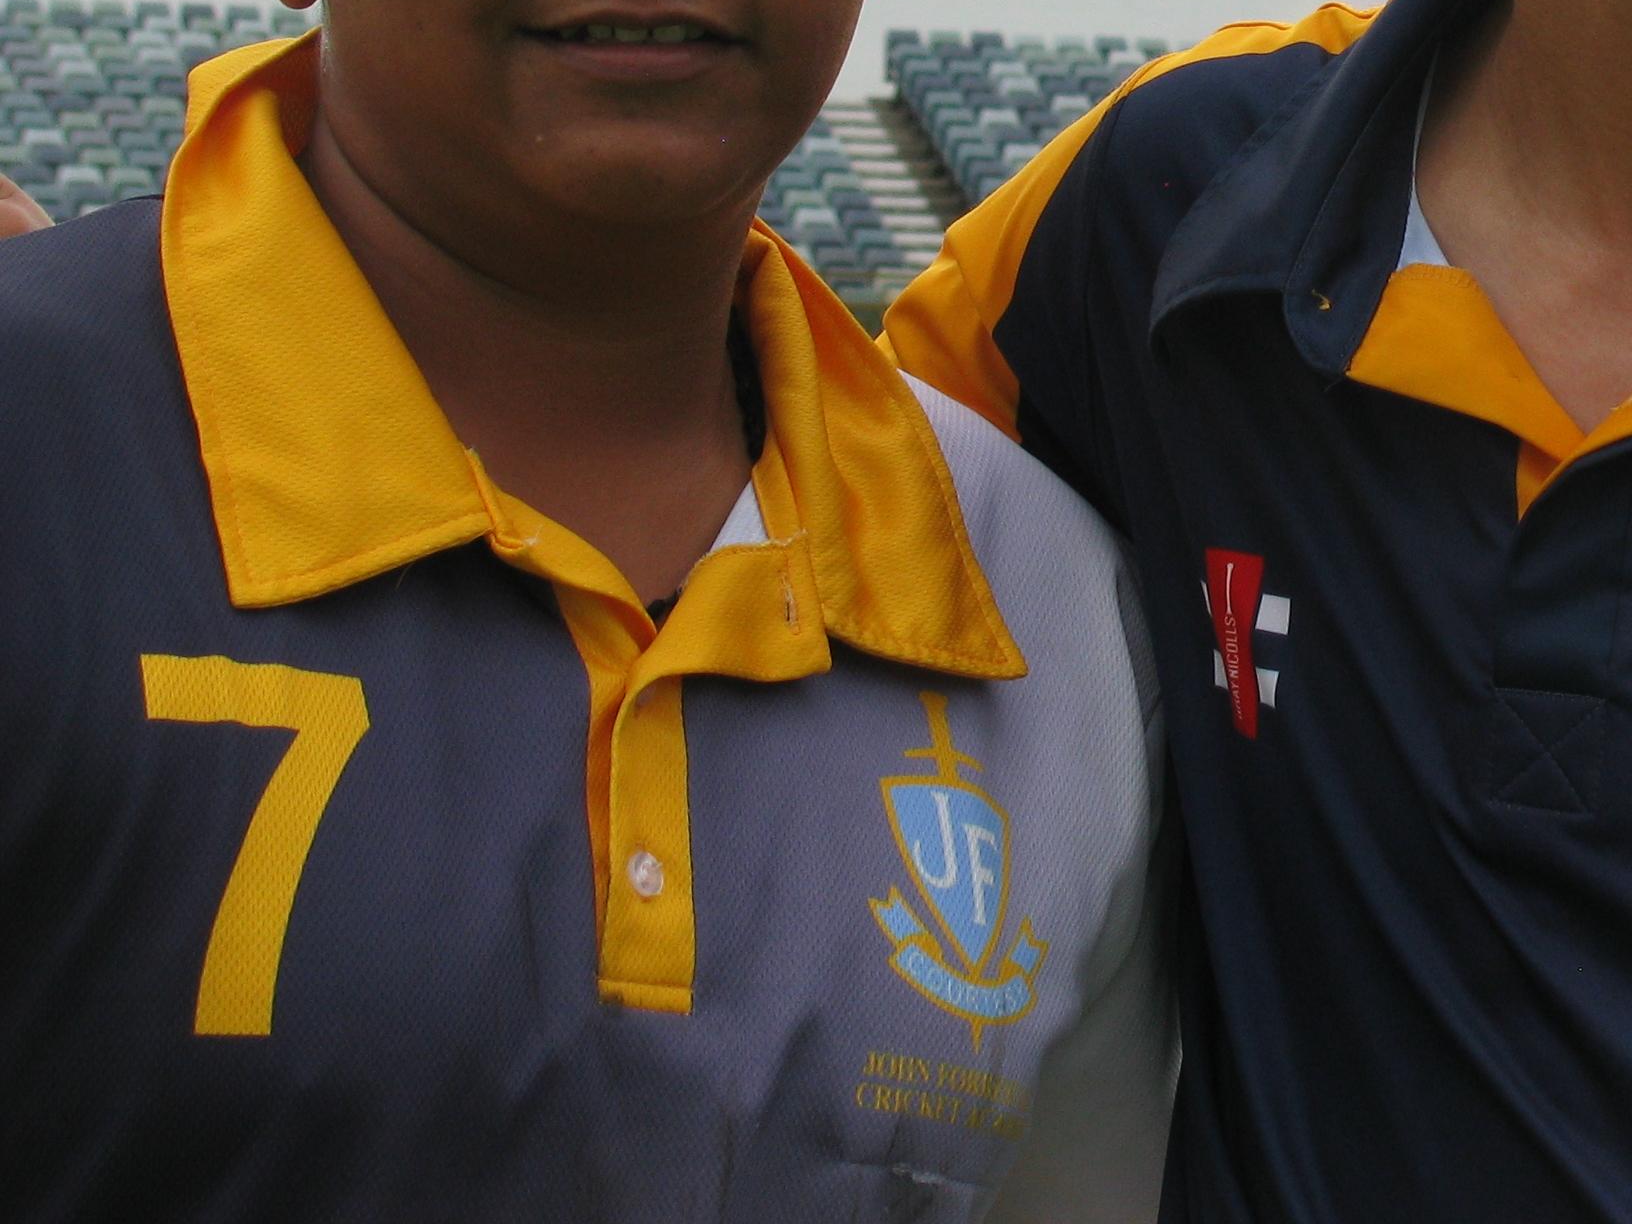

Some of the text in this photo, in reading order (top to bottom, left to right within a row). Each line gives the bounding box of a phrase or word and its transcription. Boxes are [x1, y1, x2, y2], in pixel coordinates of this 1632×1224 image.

[139, 653, 370, 1035] 7
[913, 790, 999, 926] JF
[855, 1081, 963, 1126] CRICKET
[863, 1051, 930, 1082] JOHN
